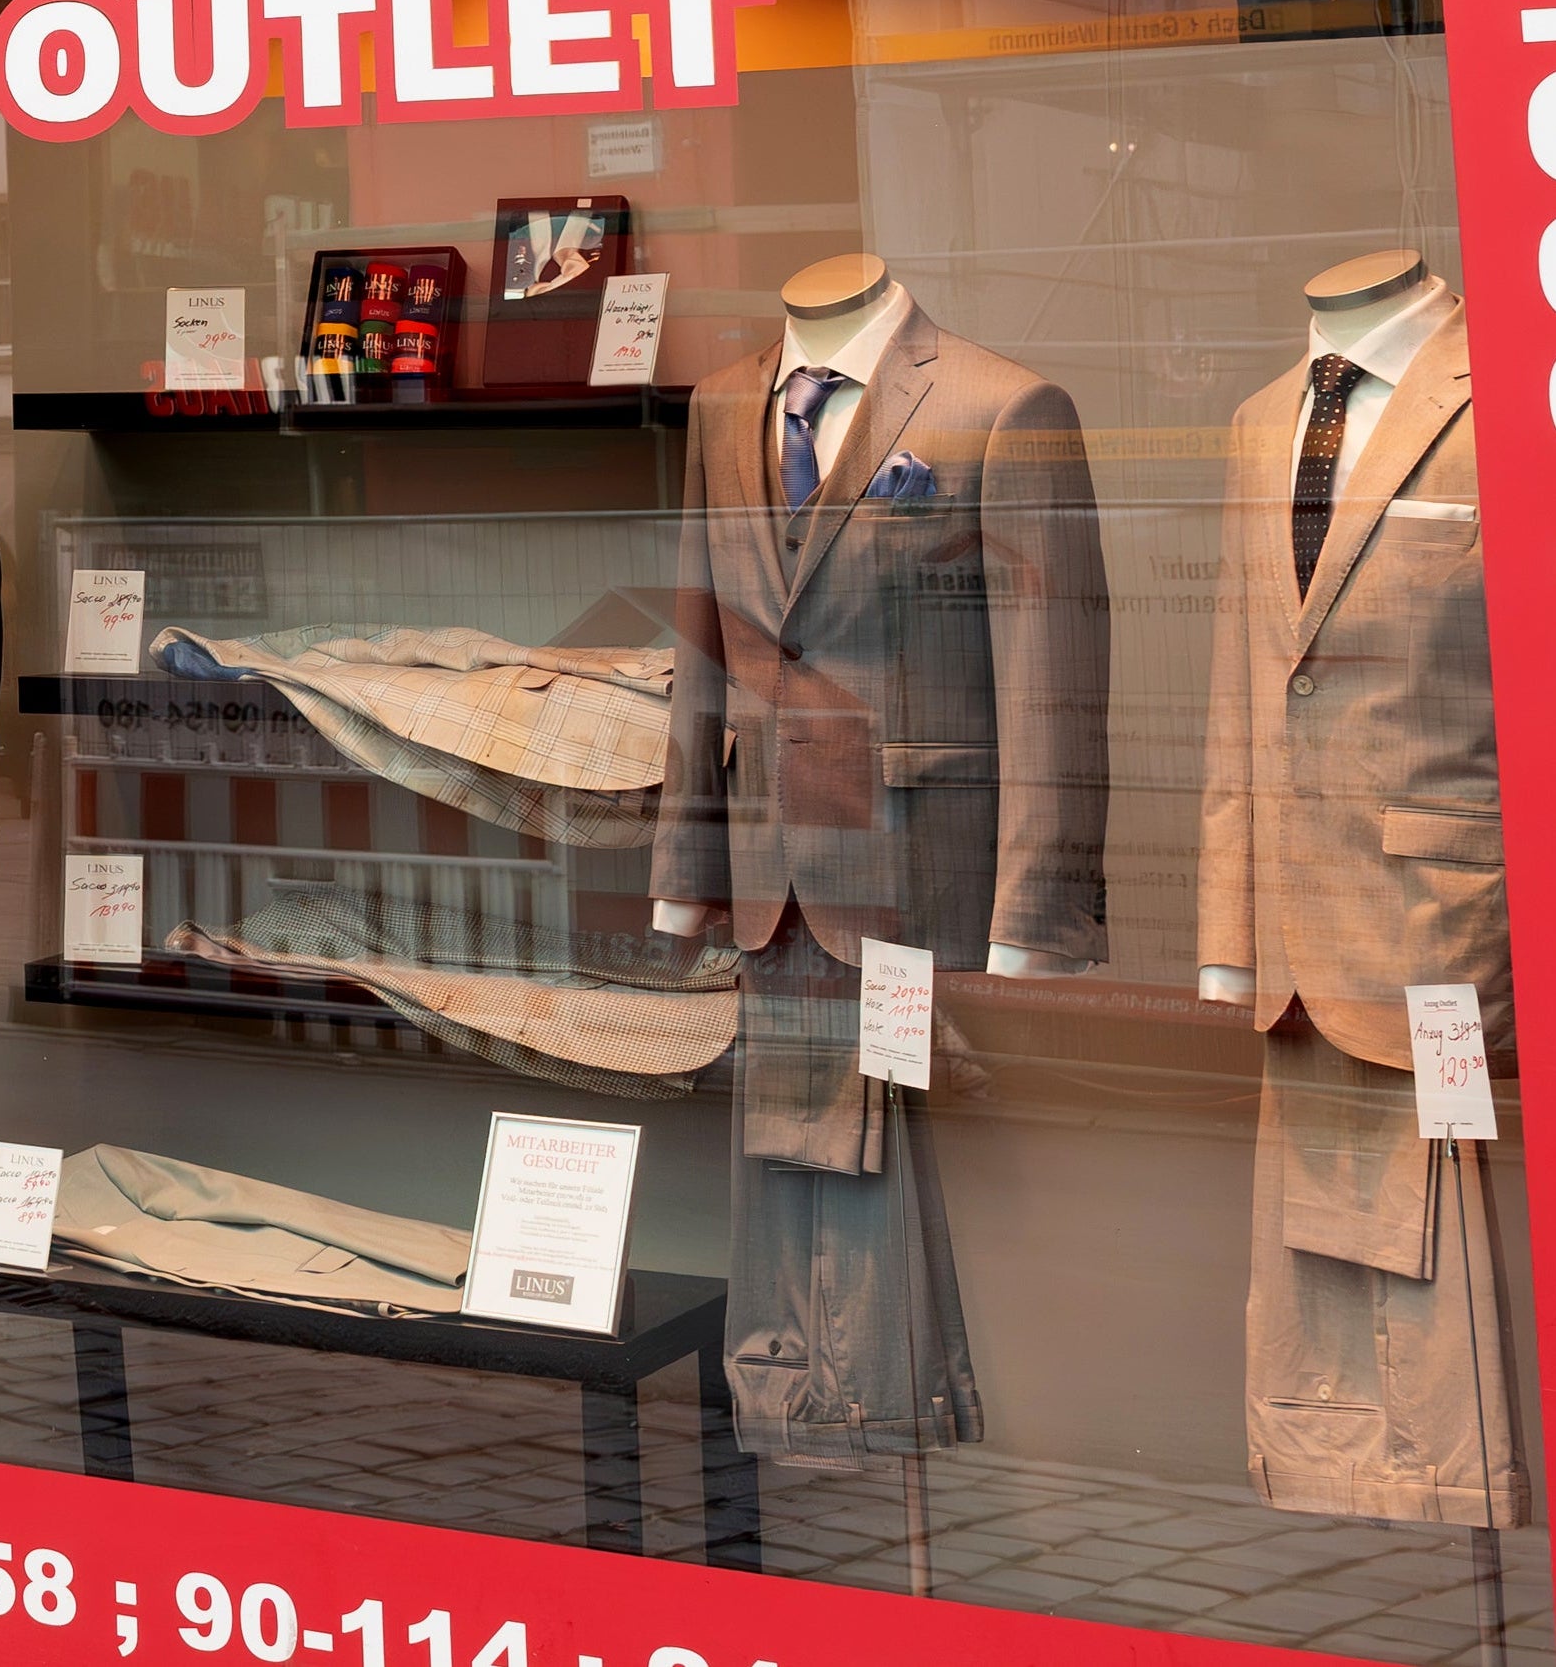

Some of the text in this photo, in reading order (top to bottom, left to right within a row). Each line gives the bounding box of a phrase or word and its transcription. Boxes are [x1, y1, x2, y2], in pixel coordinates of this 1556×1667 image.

[622, 282, 653, 294] LINUS
[189, 297, 225, 308] LINUS
[397, 337, 432, 350] LINUS
[94, 575, 128, 585] LINUS
[88, 863, 124, 874] LINUS
[879, 963, 907, 978] LINUS
[506, 1134, 617, 1159] MITARBEITER
[10, 1154, 45, 1167] LINUS
[522, 1153, 600, 1175] GESUCHT
[175, 1572, 529, 1667] 90-114
